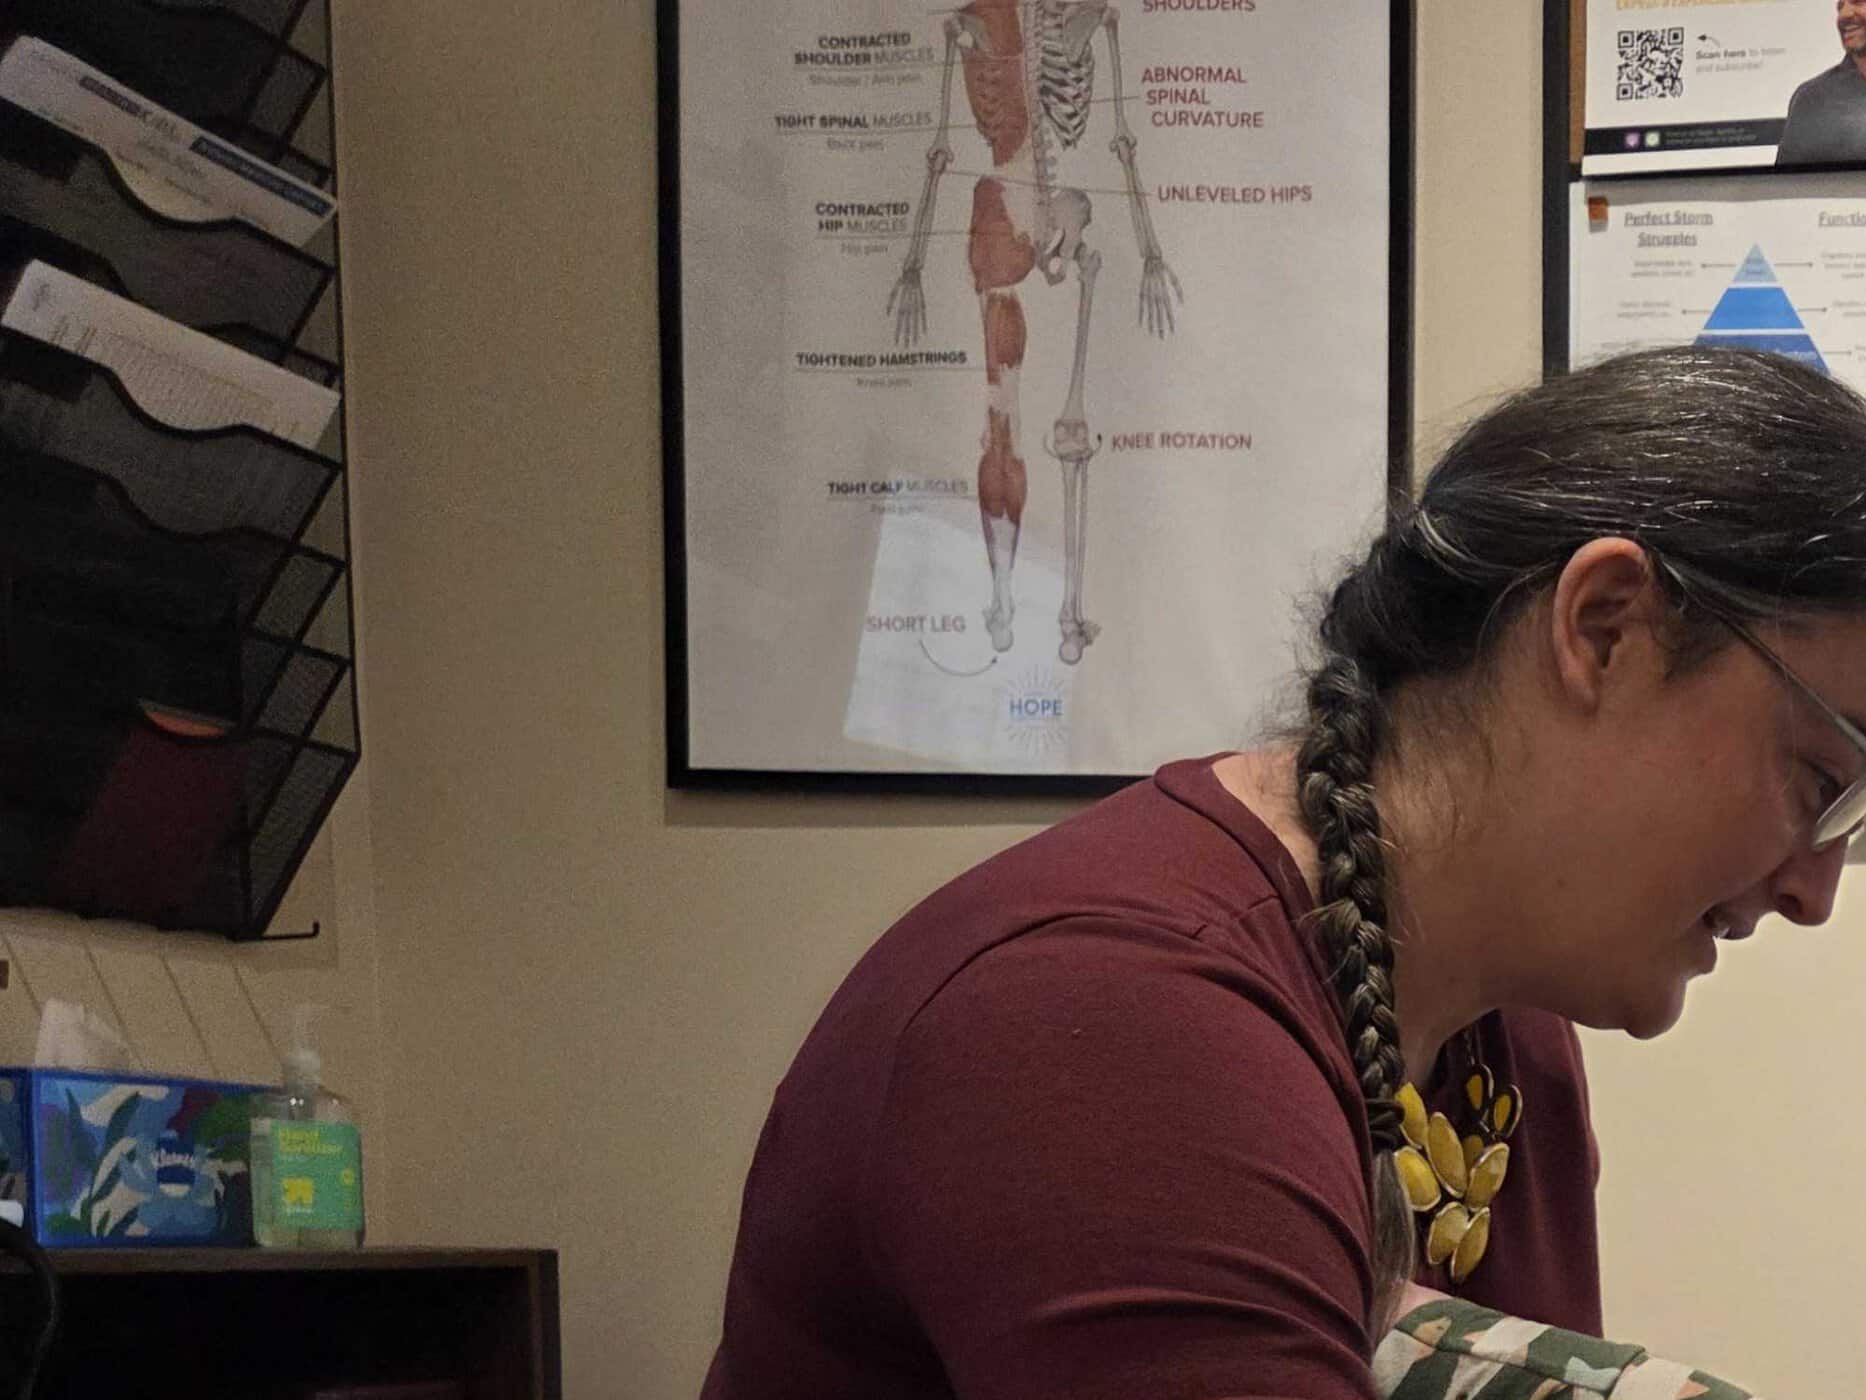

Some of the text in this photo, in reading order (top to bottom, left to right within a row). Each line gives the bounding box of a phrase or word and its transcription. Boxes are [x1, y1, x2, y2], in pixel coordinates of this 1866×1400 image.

[818, 32, 911, 49] CONTRACTED
[794, 48, 935, 65] SHOULDER MUSCLES
[1141, 66, 1247, 84] ABNORMAL
[1145, 88, 1211, 105] SPINAL
[775, 115, 815, 128] TIGHT
[819, 115, 869, 128] SPINAL
[1151, 111, 1264, 128] CURVATURE
[1158, 185, 1312, 204] UNLEVELED HIPS
[815, 202, 910, 217] CONTRACTED
[818, 219, 908, 232] HIP MUSCLES
[1624, 211, 1670, 227] Perfect
[796, 351, 967, 367] TIGHTENED HAMSTRINGS
[1111, 431, 1252, 452] KNEE ROTATION
[827, 482, 867, 495] TIGHT
[866, 616, 966, 632] SHORT LEG
[1009, 700, 1063, 717] HOPE
